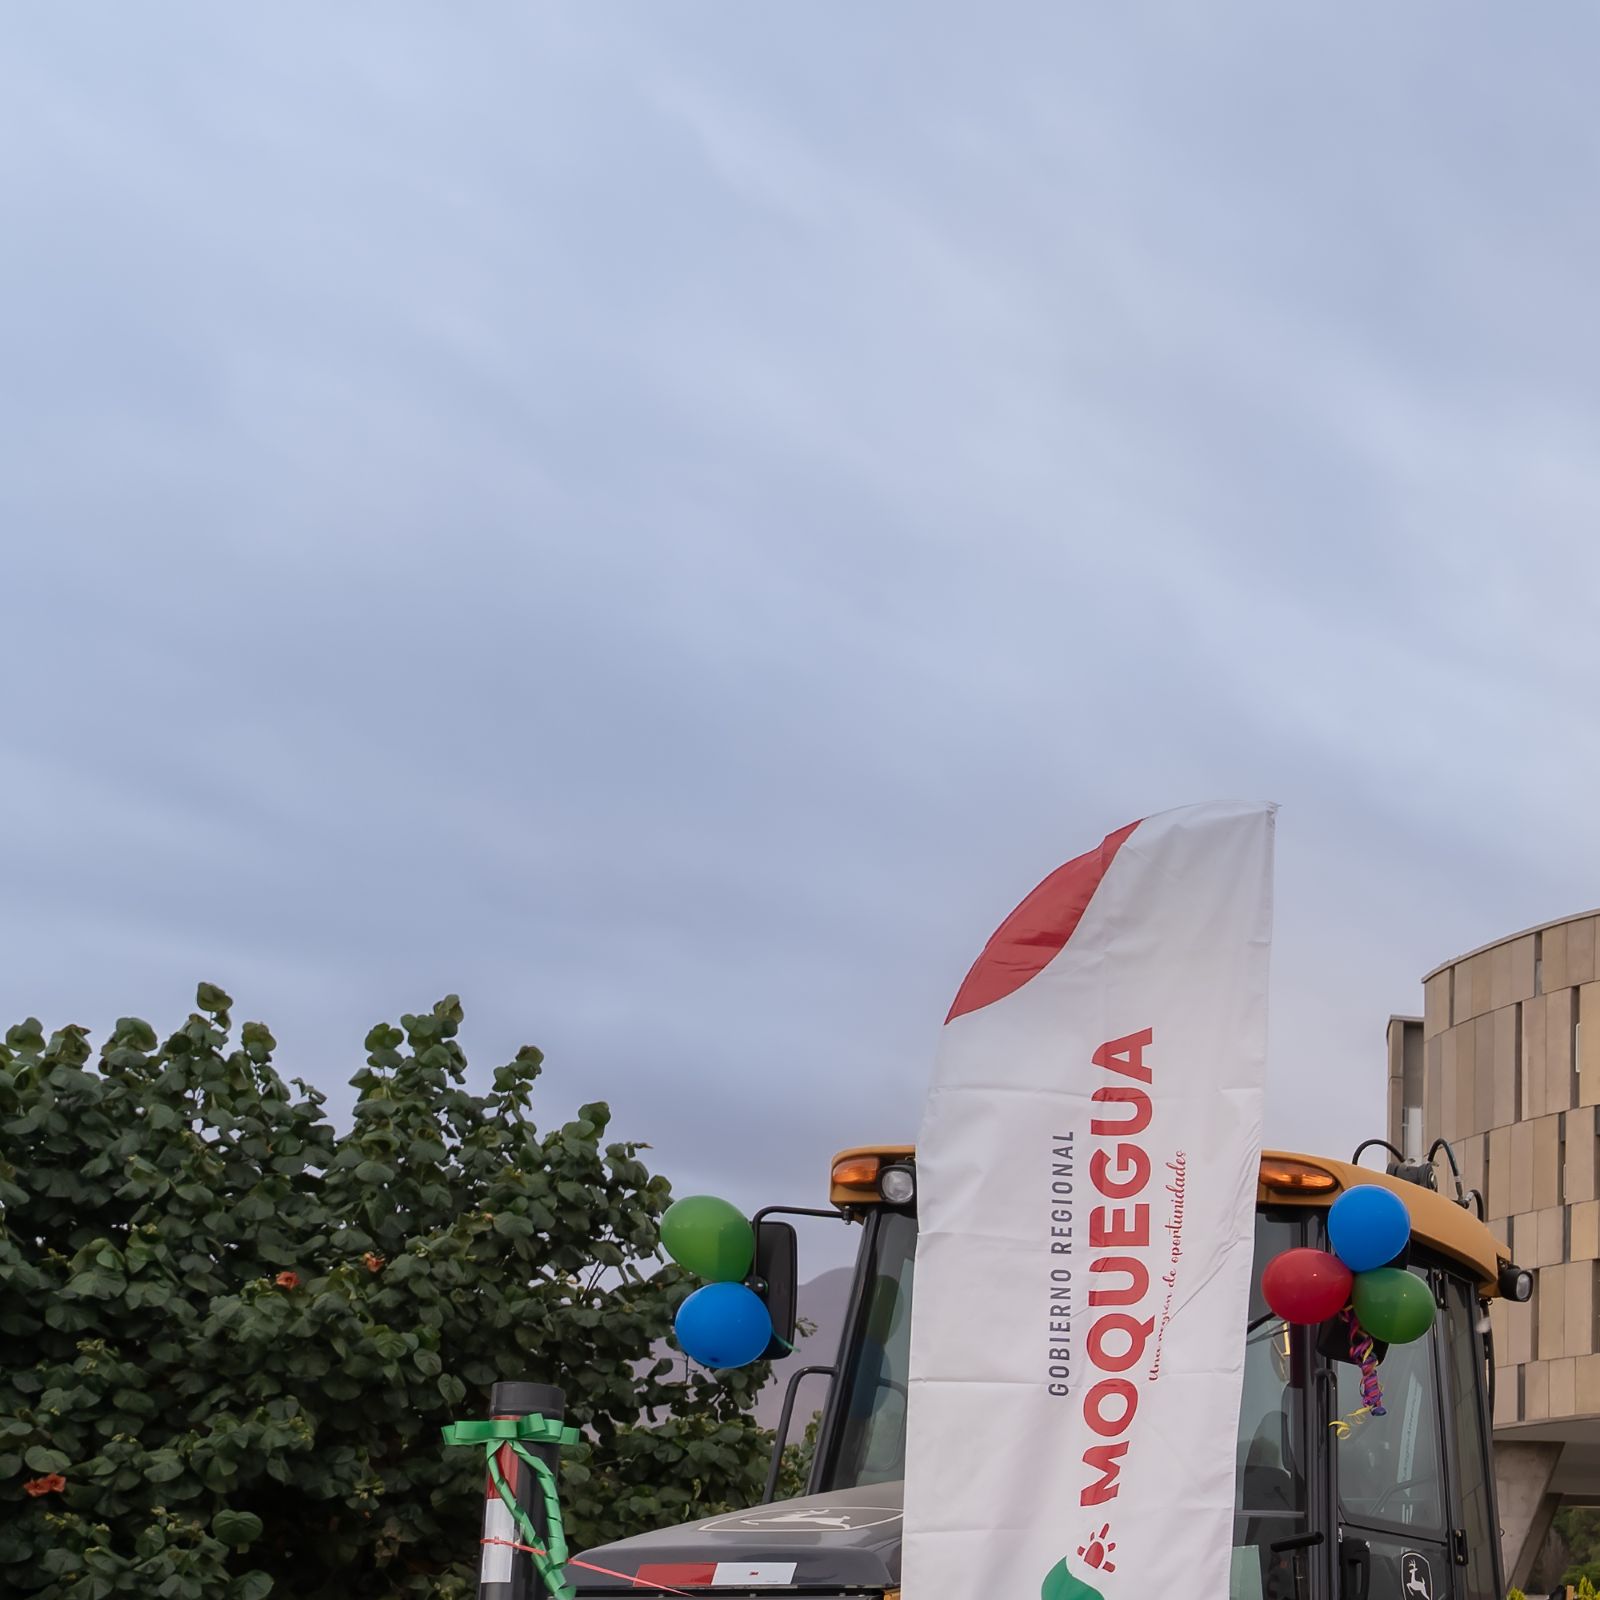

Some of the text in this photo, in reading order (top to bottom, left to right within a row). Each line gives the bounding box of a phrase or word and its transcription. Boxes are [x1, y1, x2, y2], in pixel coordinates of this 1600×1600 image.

[1048, 1131, 1074, 1397] GOBIERNO REGIONAL
[1080, 1026, 1156, 1507] MOQUEGUA
[1162, 1269, 1176, 1288] de
[1164, 1150, 1187, 1263] oportunidades
